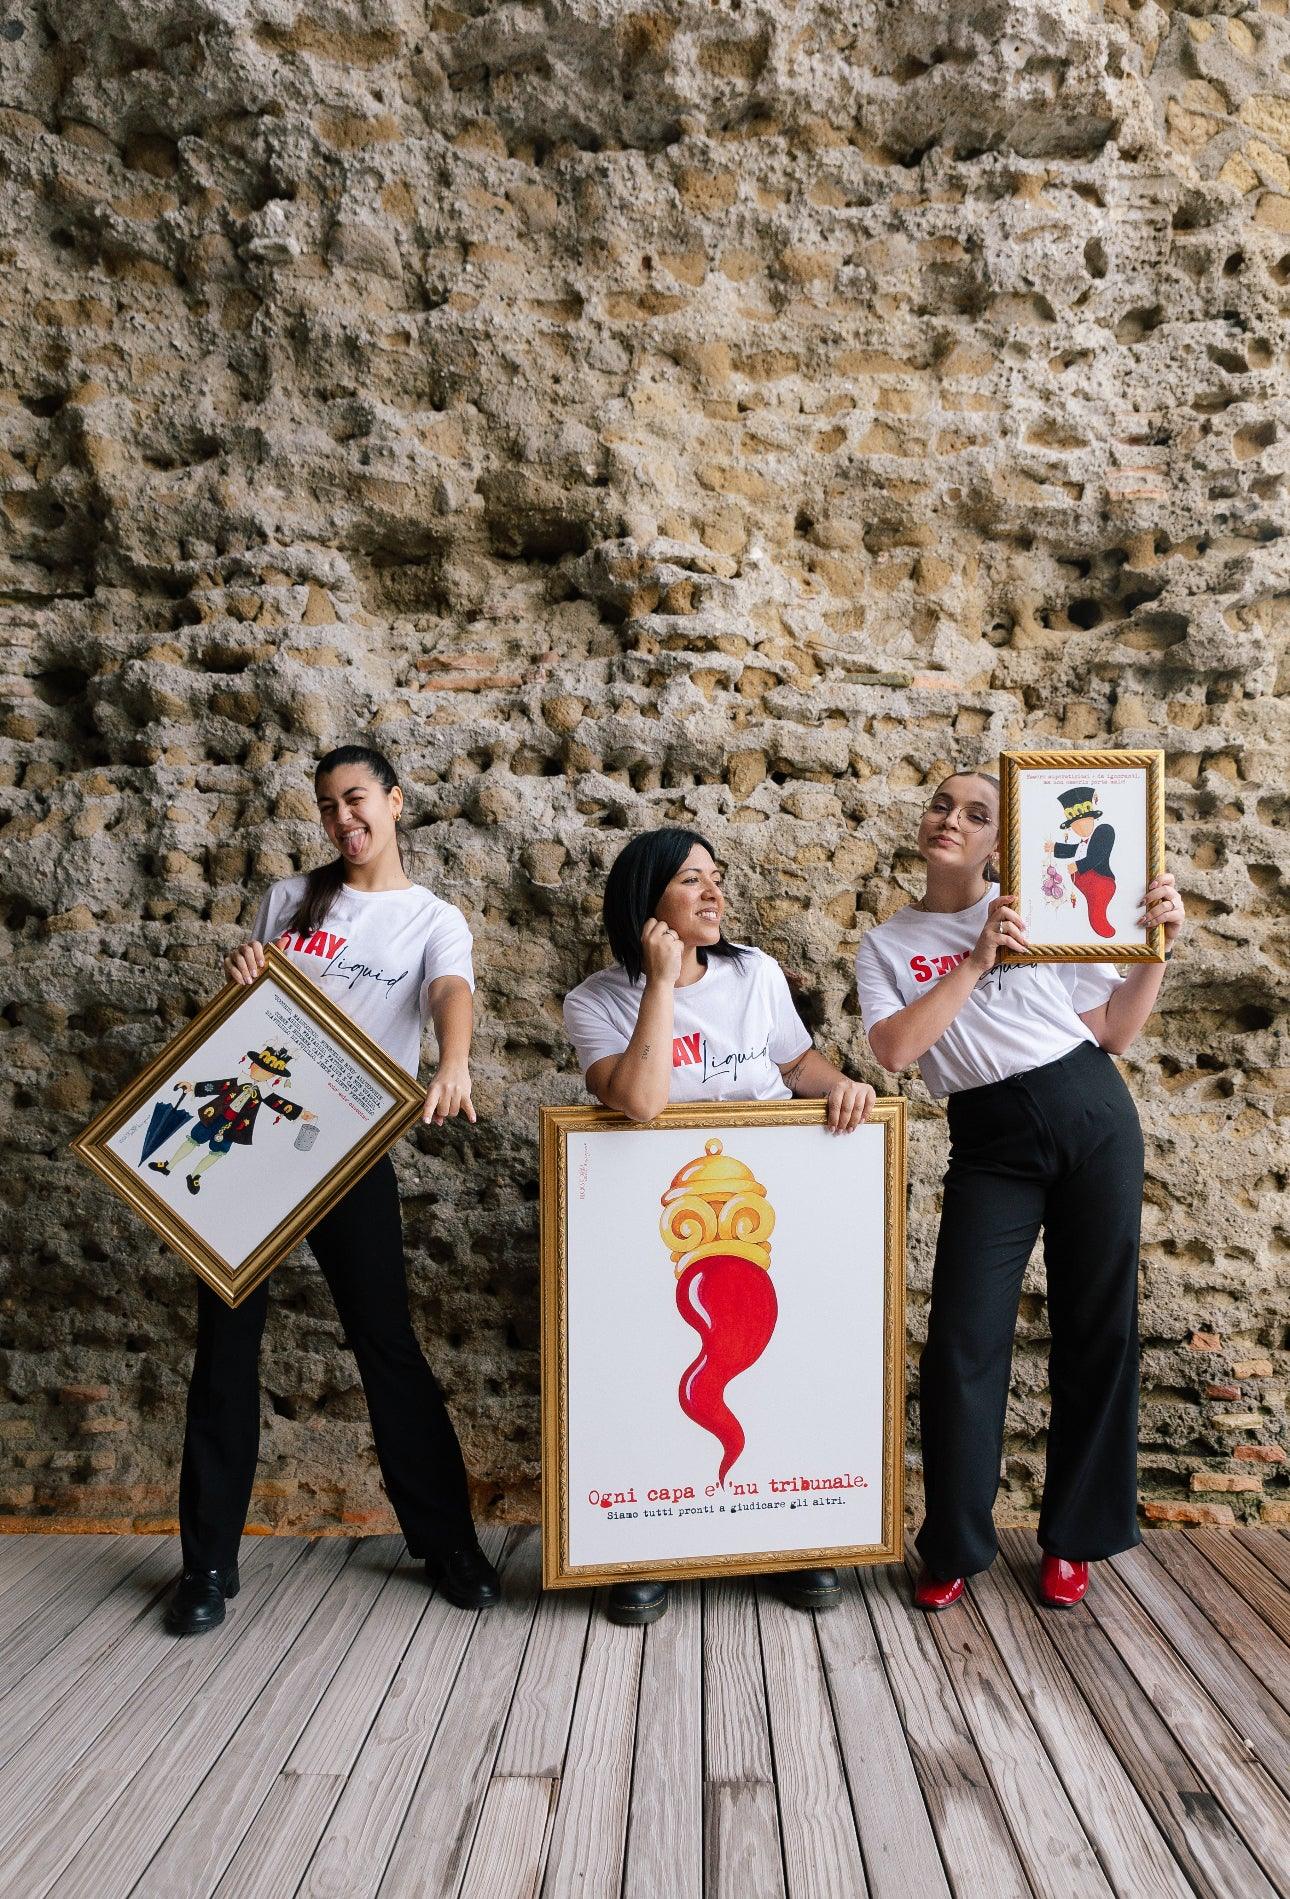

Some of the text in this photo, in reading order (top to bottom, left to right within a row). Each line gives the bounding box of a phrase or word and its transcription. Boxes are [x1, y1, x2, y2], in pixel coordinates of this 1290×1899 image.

[320, 945, 409, 999] Liquid
[588, 1488, 637, 1508] Ogni
[648, 1487, 695, 1503] capa
[769, 1474, 868, 1492] tribunale.
[607, 1510, 638, 1520] Siamo
[643, 1508, 673, 1518] tutti
[679, 1506, 715, 1516] pronti
[731, 1501, 785, 1513] giudicare
[790, 1498, 808, 1509] gli
[813, 1496, 846, 1506] altri.
